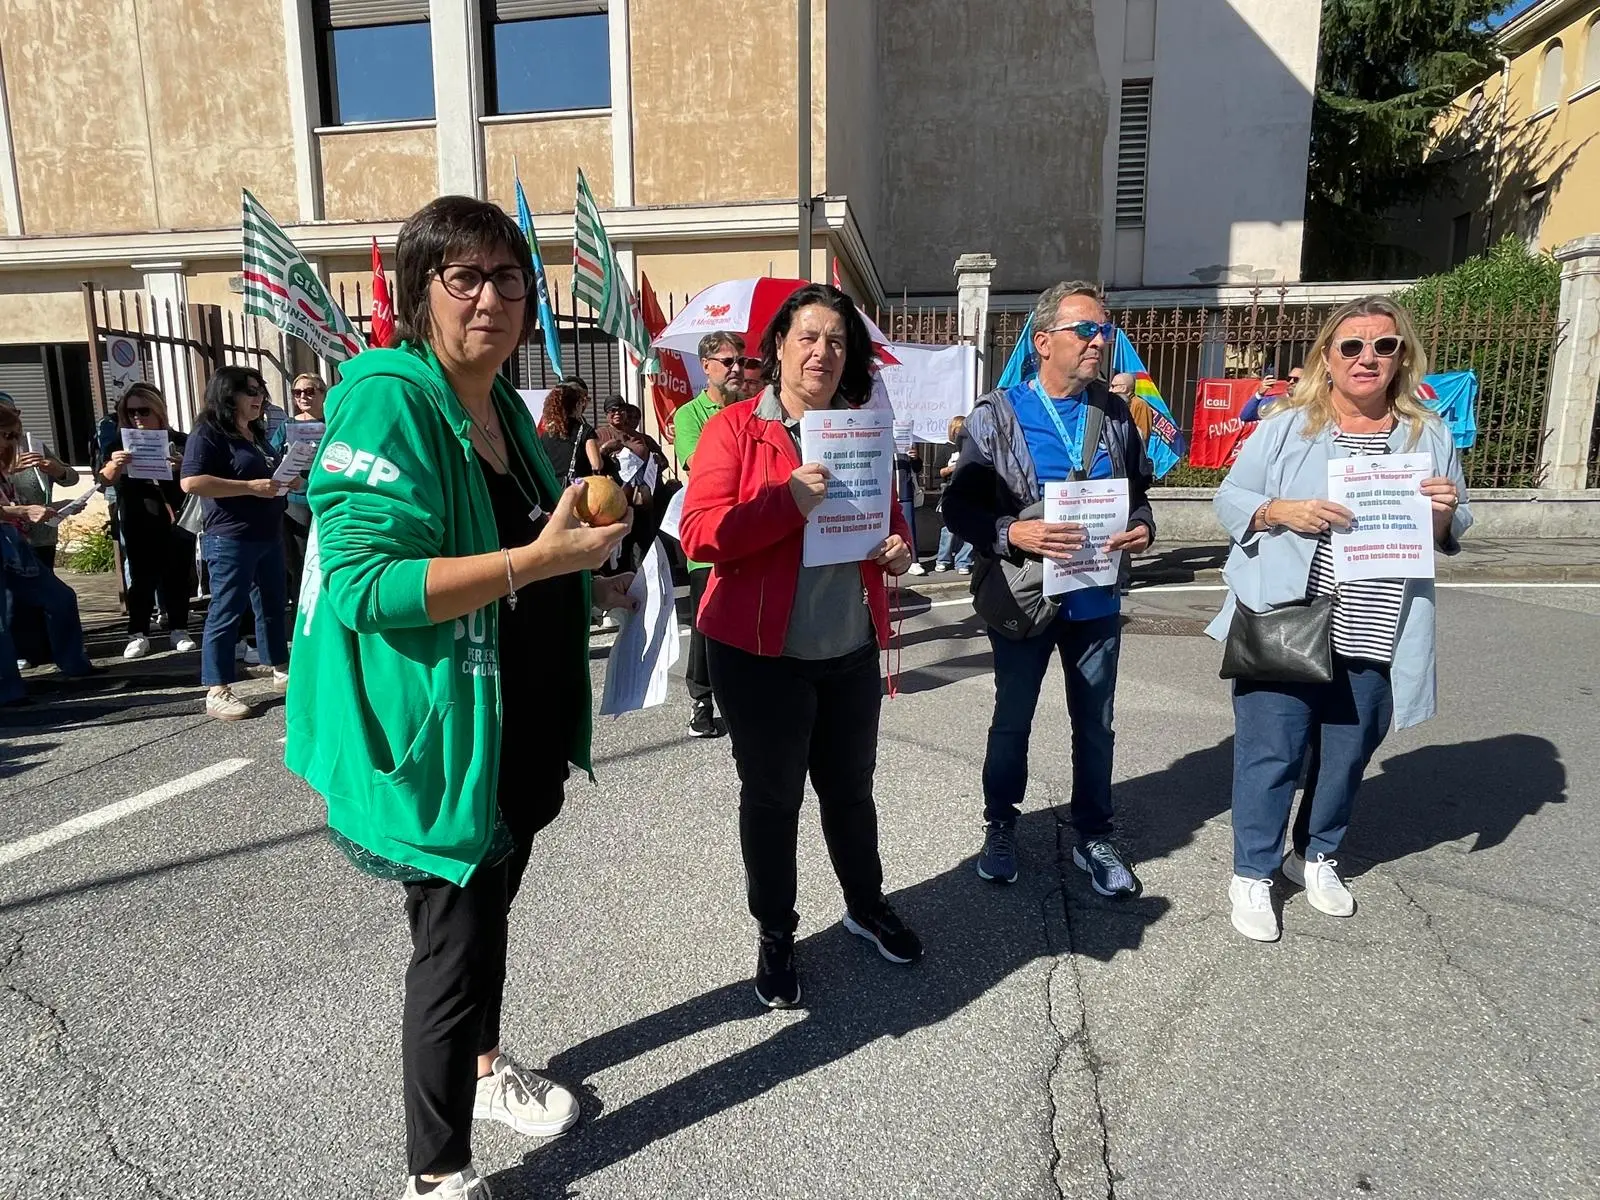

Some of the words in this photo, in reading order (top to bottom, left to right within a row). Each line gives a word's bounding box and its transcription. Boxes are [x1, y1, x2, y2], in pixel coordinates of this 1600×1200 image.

[273, 298, 330, 346] FUNZIONE
[277, 318, 325, 358] UBBLICA
[1207, 399, 1229, 407] CGIL
[822, 431, 847, 439] Chiusura
[823, 451, 832, 460] 40
[833, 450, 848, 459] anni
[849, 449, 856, 458] di
[344, 449, 401, 487] FP
[827, 480, 852, 488] utelate
[1344, 475, 1372, 483] Chiusura
[1356, 490, 1373, 498] anni
[1383, 489, 1415, 498] impegno
[818, 514, 856, 524] Difendiamo
[857, 513, 866, 521] chi
[867, 512, 884, 520] lavora
[1059, 513, 1067, 521] 40
[1068, 511, 1081, 521] anni
[1089, 510, 1117, 520] impegno
[826, 525, 841, 533] lotta
[843, 524, 867, 532] insieme
[1344, 544, 1385, 553] Difendiamo
[1386, 543, 1398, 551] chi
[1399, 542, 1423, 550] lavora
[1353, 552, 1369, 561] lotta
[1371, 551, 1400, 560] insieme
[1408, 551, 1420, 559] noi
[1060, 570, 1072, 578] lotta
